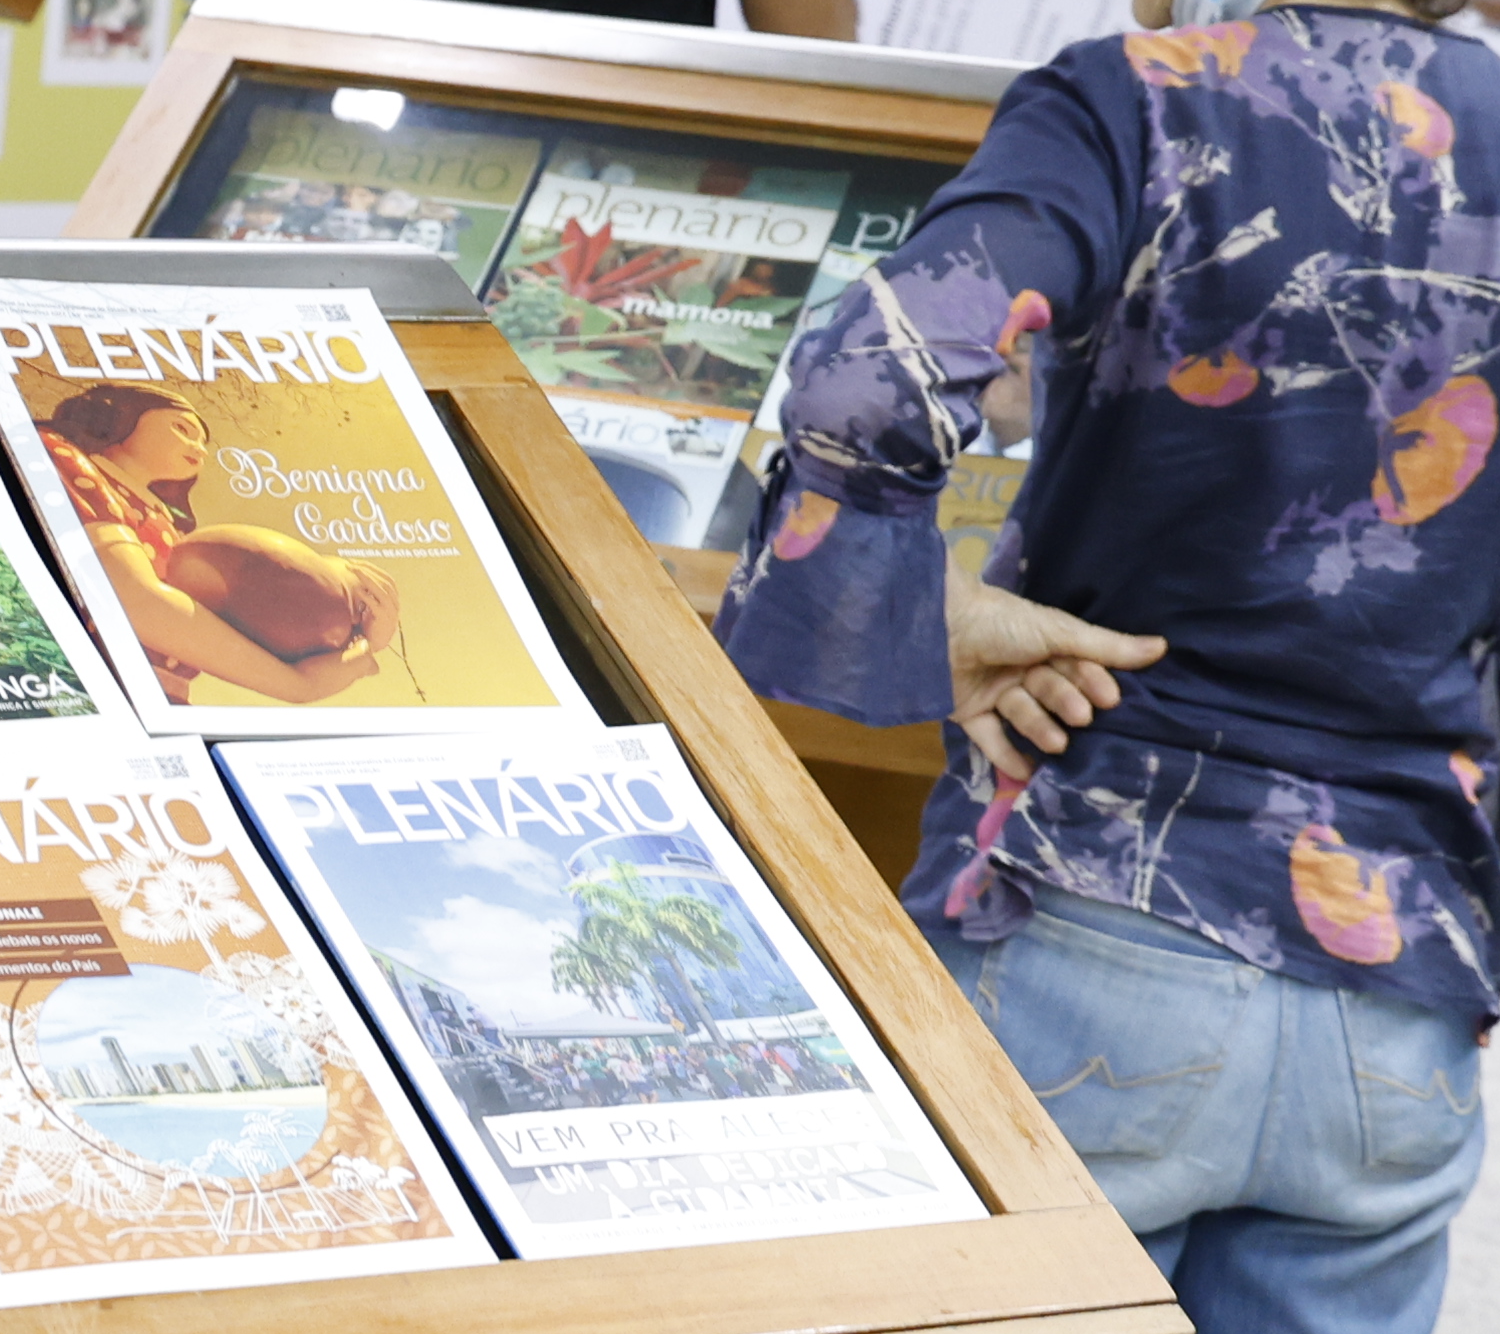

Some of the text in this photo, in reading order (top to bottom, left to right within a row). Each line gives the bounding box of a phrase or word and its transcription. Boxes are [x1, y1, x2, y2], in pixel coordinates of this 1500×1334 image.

[550, 182, 810, 247] plenário
[621, 294, 775, 330] mamona
[216, 446, 426, 522] Benigna
[293, 501, 453, 545] Cardoso
[283, 759, 691, 850] PLENÁRIO
[41, 935, 60, 946] os
[60, 932, 103, 946] novos
[52, 959, 72, 974] do
[72, 958, 102, 973] País
[495, 1122, 586, 1155] VEM
[608, 1117, 694, 1145] PRA
[533, 1142, 888, 1197] UM DIA DEDICADO
